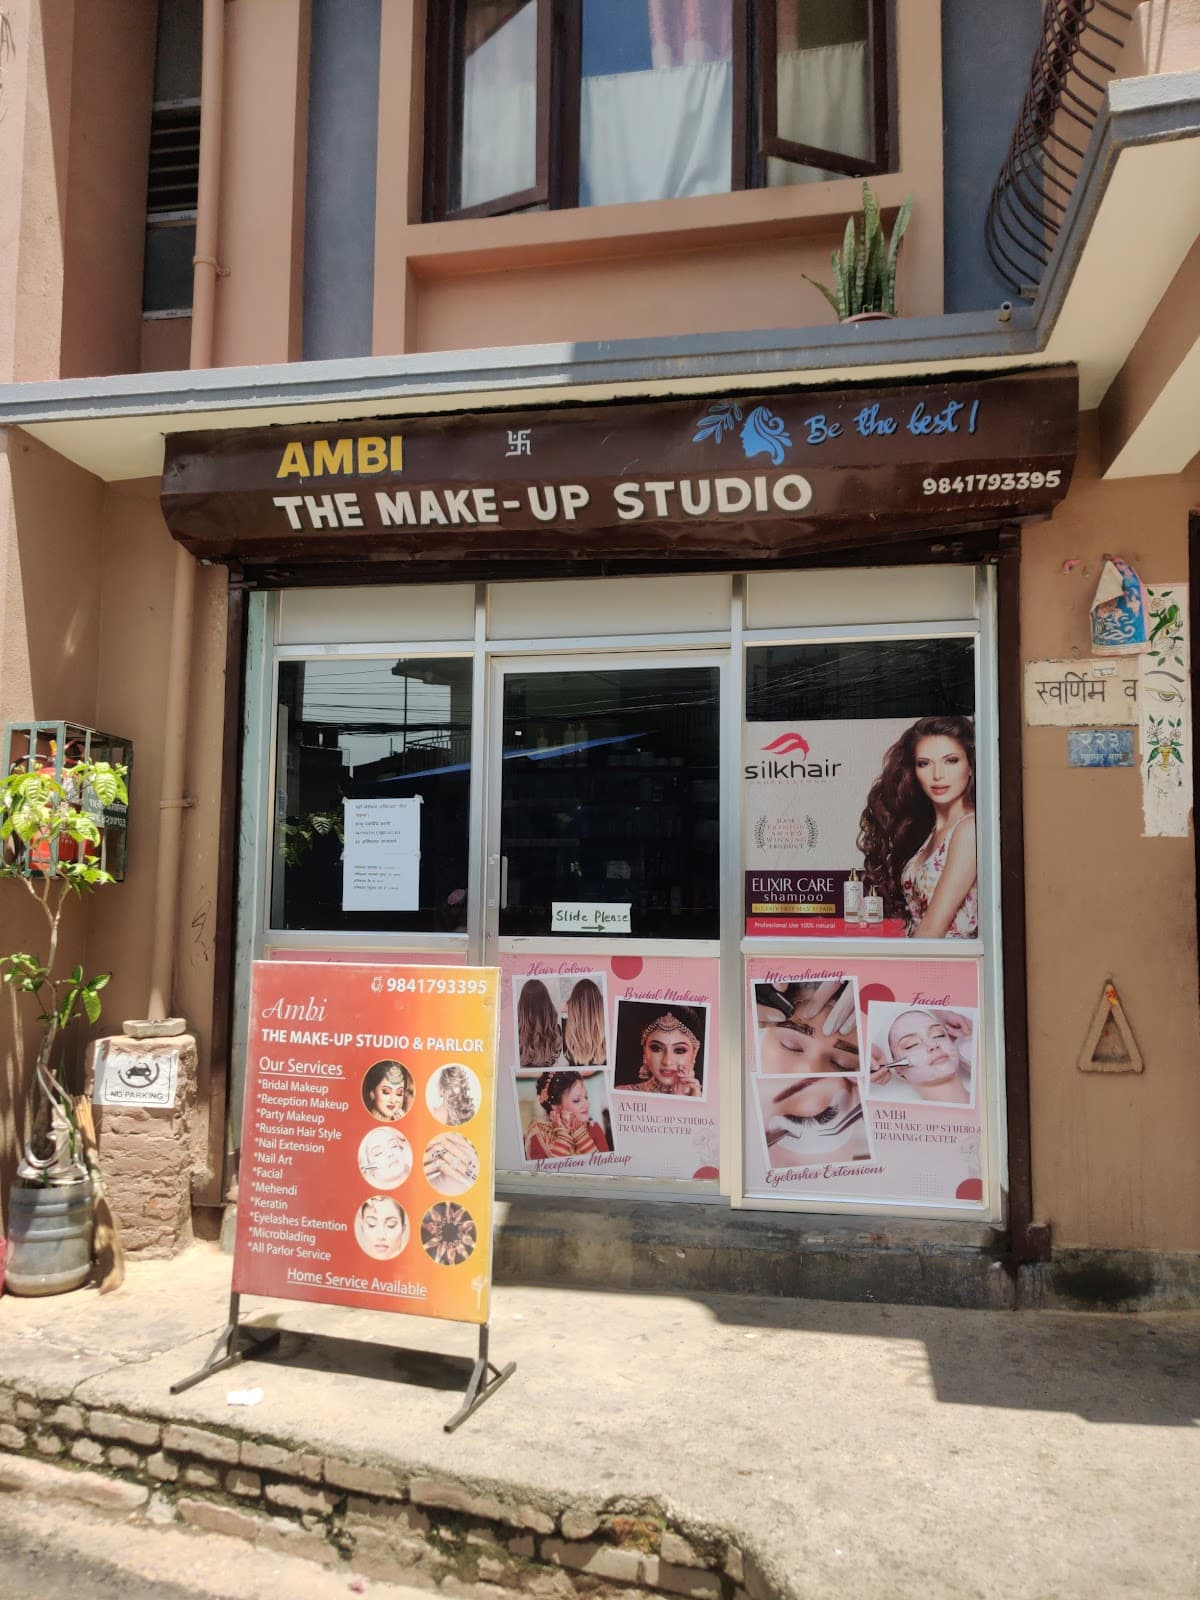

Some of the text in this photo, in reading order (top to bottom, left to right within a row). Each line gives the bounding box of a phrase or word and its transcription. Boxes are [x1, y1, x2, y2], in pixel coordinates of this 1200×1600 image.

[804, 415, 843, 444] Be
[854, 403, 898, 437] the
[276, 435, 403, 479] AMBI
[922, 470, 1061, 496] 9841793395
[272, 474, 812, 530] THE MAKE-UP STUDIO
[1034, 671, 1107, 705] स्वर्णिम
[744, 759, 842, 779] silkhair
[752, 878, 835, 892] ELIXIR CARE
[763, 892, 824, 904] shampoo
[556, 909, 628, 923] Slide Please
[387, 977, 487, 995] 9841793395
[624, 987, 661, 1000] Bridal
[909, 992, 951, 1007] Facial
[261, 997, 327, 1022] Ambi
[261, 1029, 484, 1052] THE MAKE-UP STUDIO & PARLOR
[259, 1056, 343, 1075] Our Services
[124, 1091, 163, 1100] PARKING
[290, 1081, 329, 1096] Makeup
[310, 1098, 349, 1112] Makeup
[287, 1111, 325, 1125] Makeup
[296, 1126, 315, 1137] Hair
[318, 1128, 342, 1141] Style
[279, 1140, 325, 1152] Extension
[278, 1155, 293, 1165] Art
[535, 1152, 631, 1173] Reception Makeup
[765, 1165, 886, 1187] Eyelashes Extensions
[301, 1216, 348, 1230] Extention
[266, 1244, 294, 1256] Parlor
[296, 1247, 331, 1260] Service
[287, 1267, 427, 1297] Home Service Available
